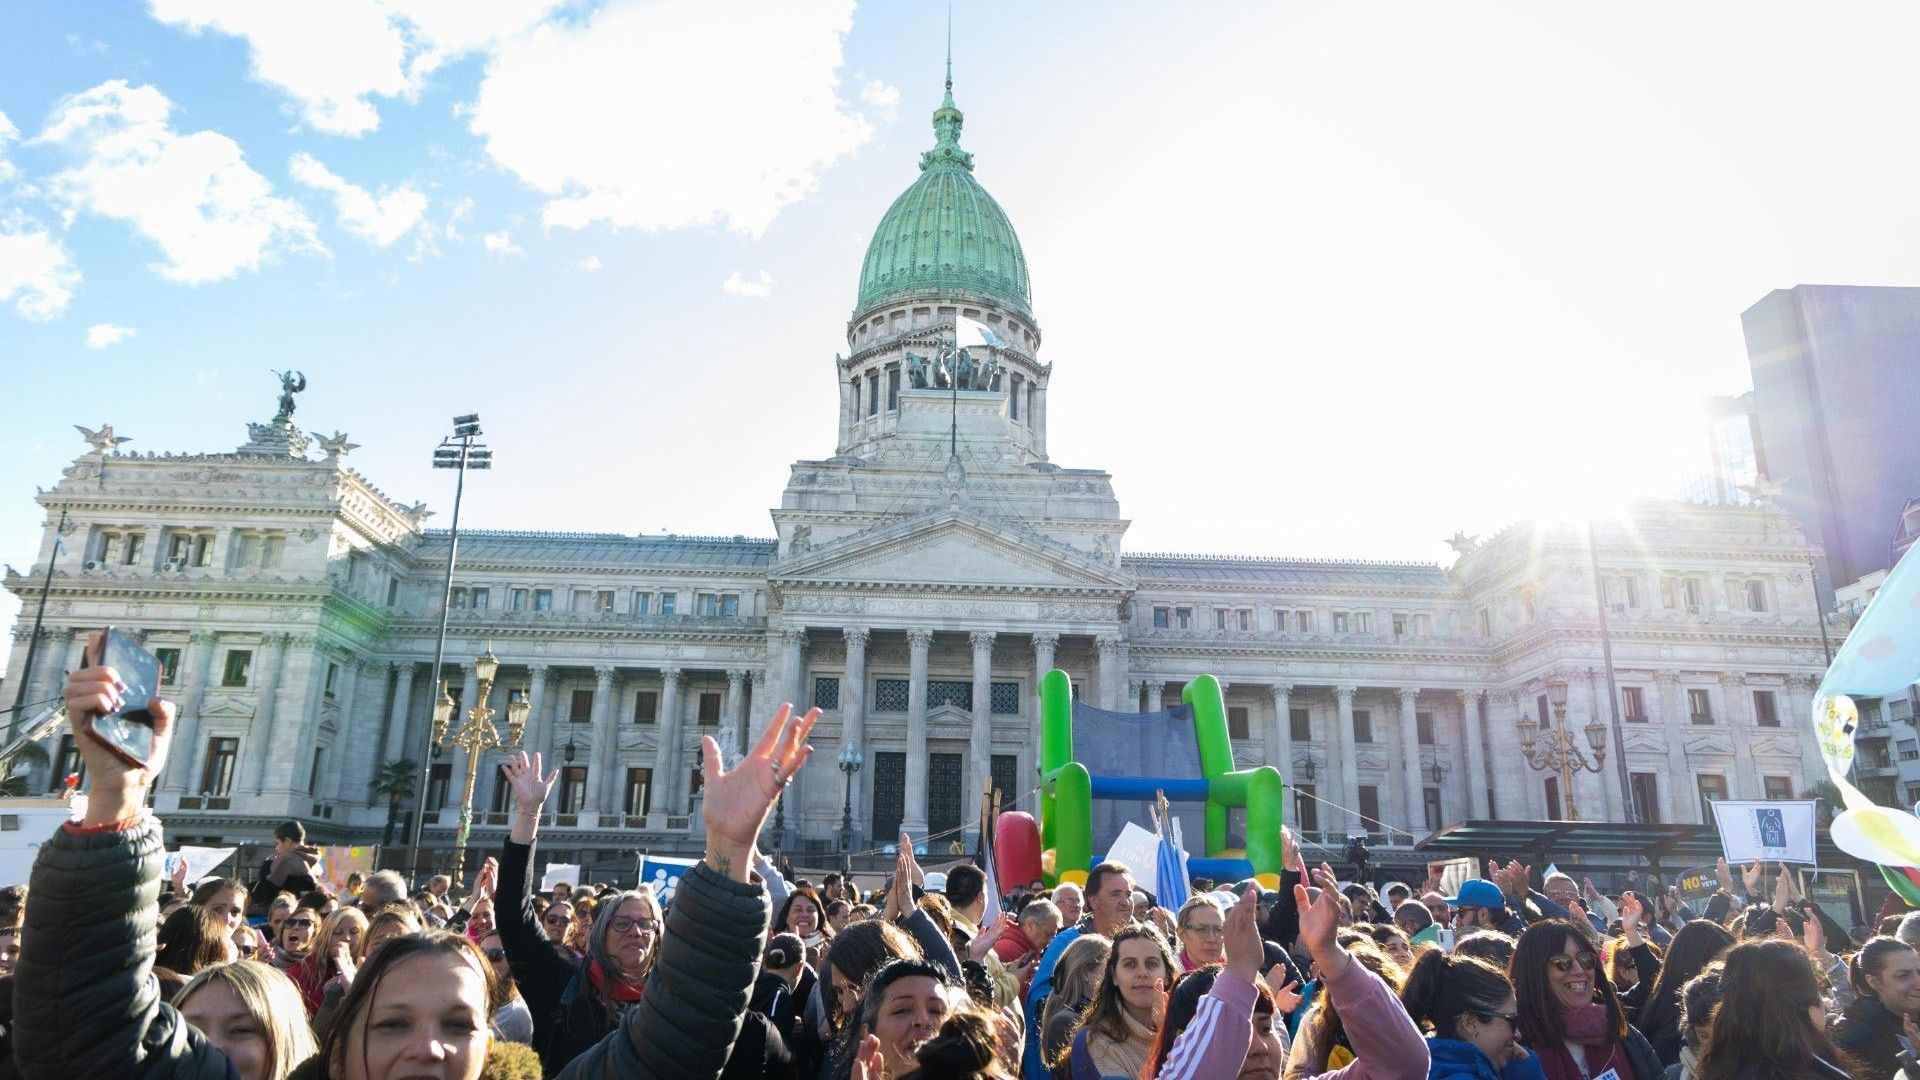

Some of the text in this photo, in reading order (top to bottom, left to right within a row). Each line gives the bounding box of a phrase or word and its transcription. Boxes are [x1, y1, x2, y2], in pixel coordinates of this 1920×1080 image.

[879, 602, 1025, 616] CONGRESO NACIONAL
[1682, 876, 1700, 890] NO
[1701, 879, 1717, 888] VETO
